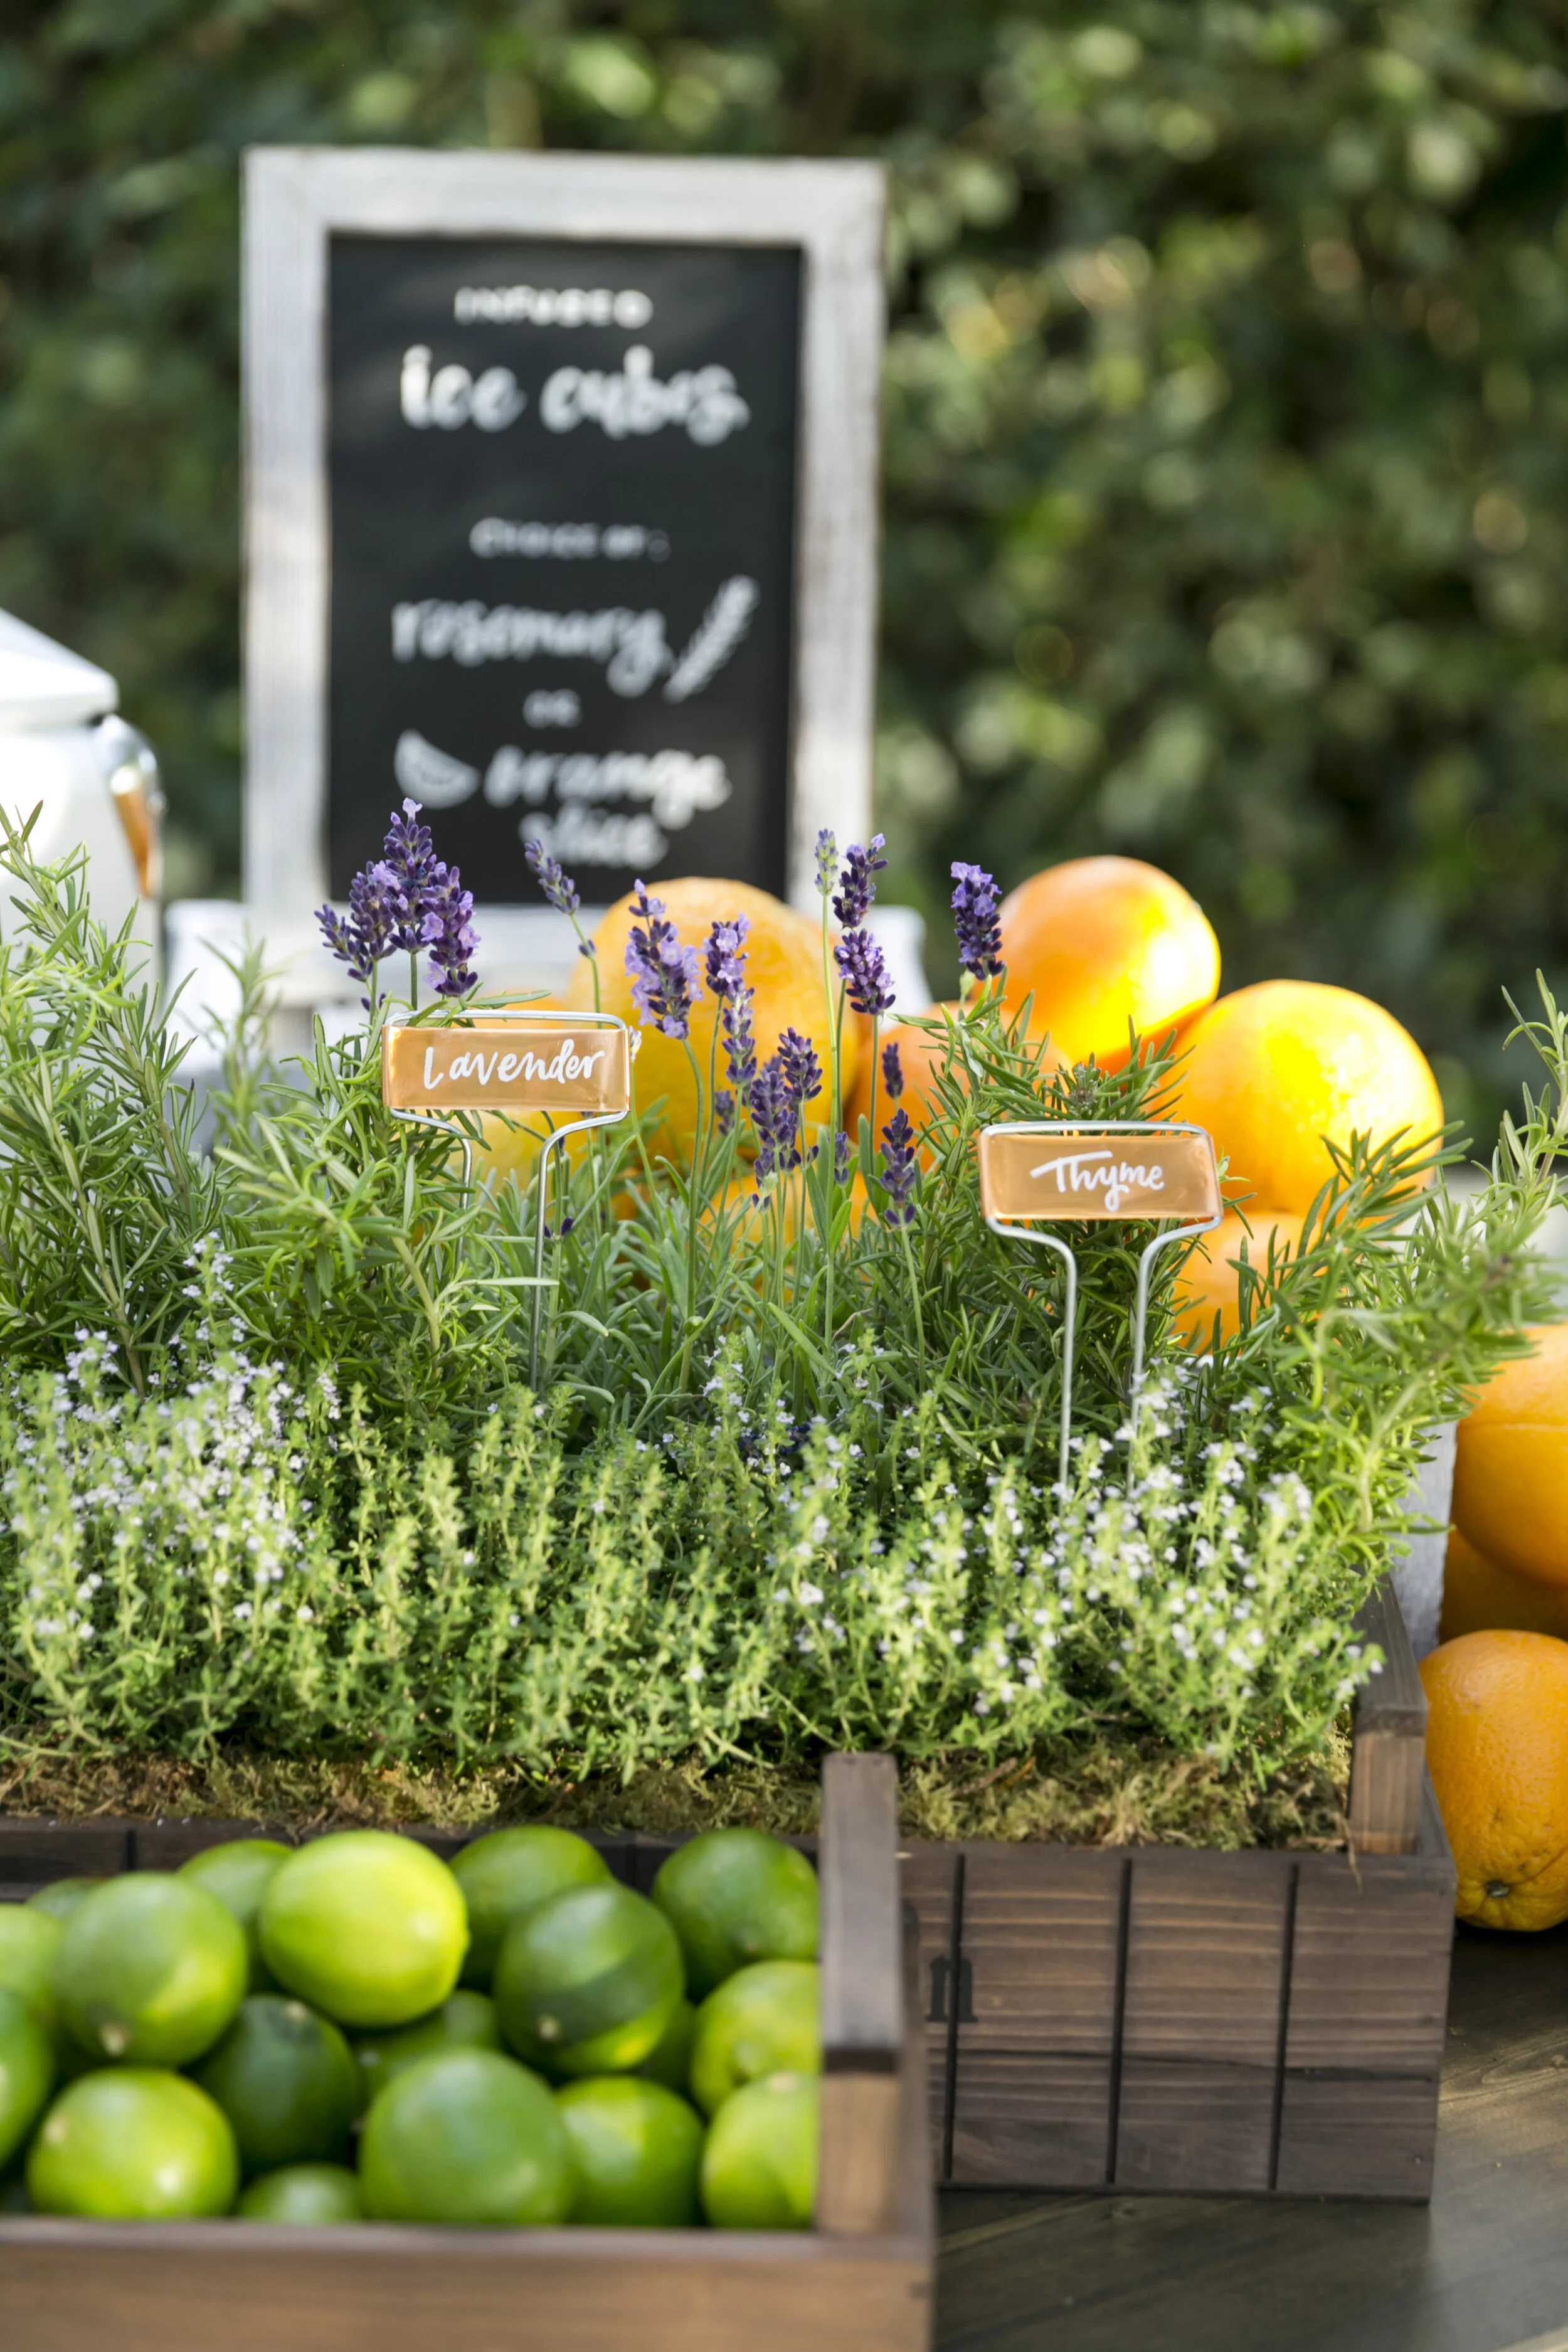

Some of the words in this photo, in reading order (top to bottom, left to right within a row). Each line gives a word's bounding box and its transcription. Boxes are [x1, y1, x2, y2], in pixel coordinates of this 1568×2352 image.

[401, 344, 527, 433] ice
[540, 344, 750, 446] cubes
[392, 598, 675, 697] rosemary
[484, 745, 731, 829] orange
[423, 1039, 605, 1090] Lavender
[1030, 1150, 1165, 1212] Thyme
